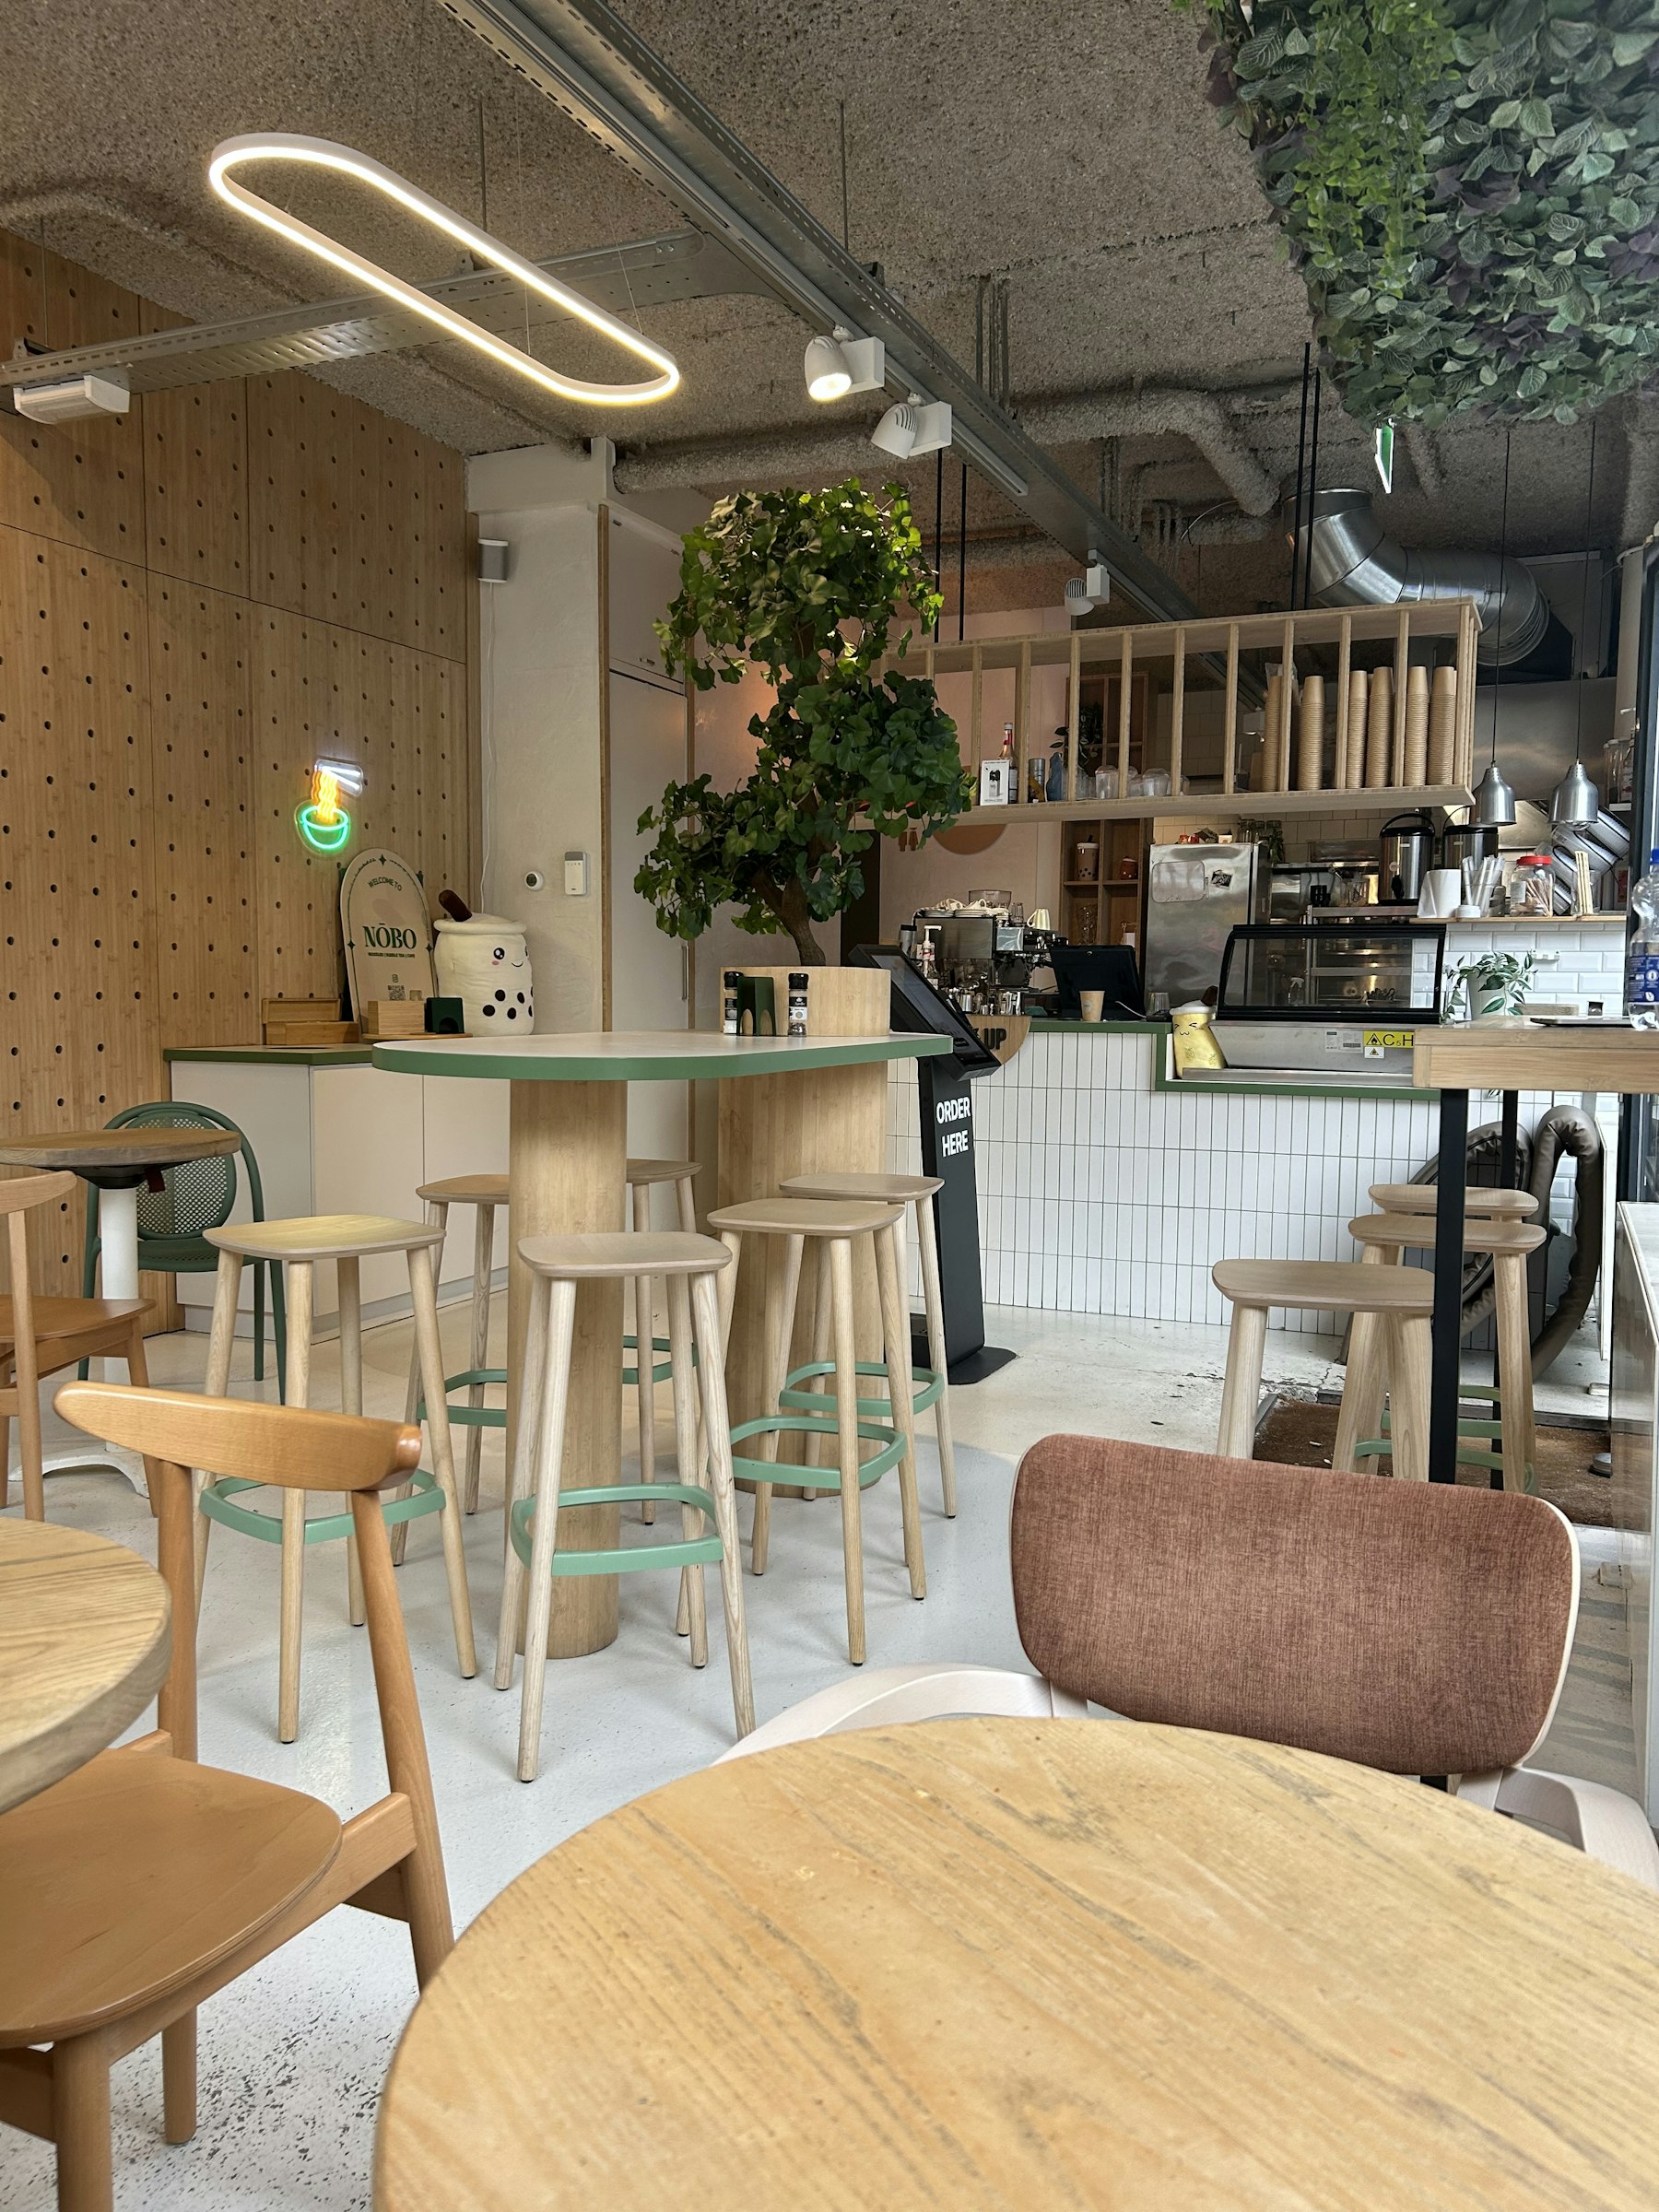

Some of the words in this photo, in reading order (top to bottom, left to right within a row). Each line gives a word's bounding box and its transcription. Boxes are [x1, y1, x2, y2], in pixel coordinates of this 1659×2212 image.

[368, 877, 394, 888] WELCOME
[394, 881, 403, 891] TO
[362, 923, 417, 949] NŌBO
[983, 1028, 1006, 1050] UP
[936, 1096, 971, 1124] ORDER
[942, 1130, 969, 1158] HERE
